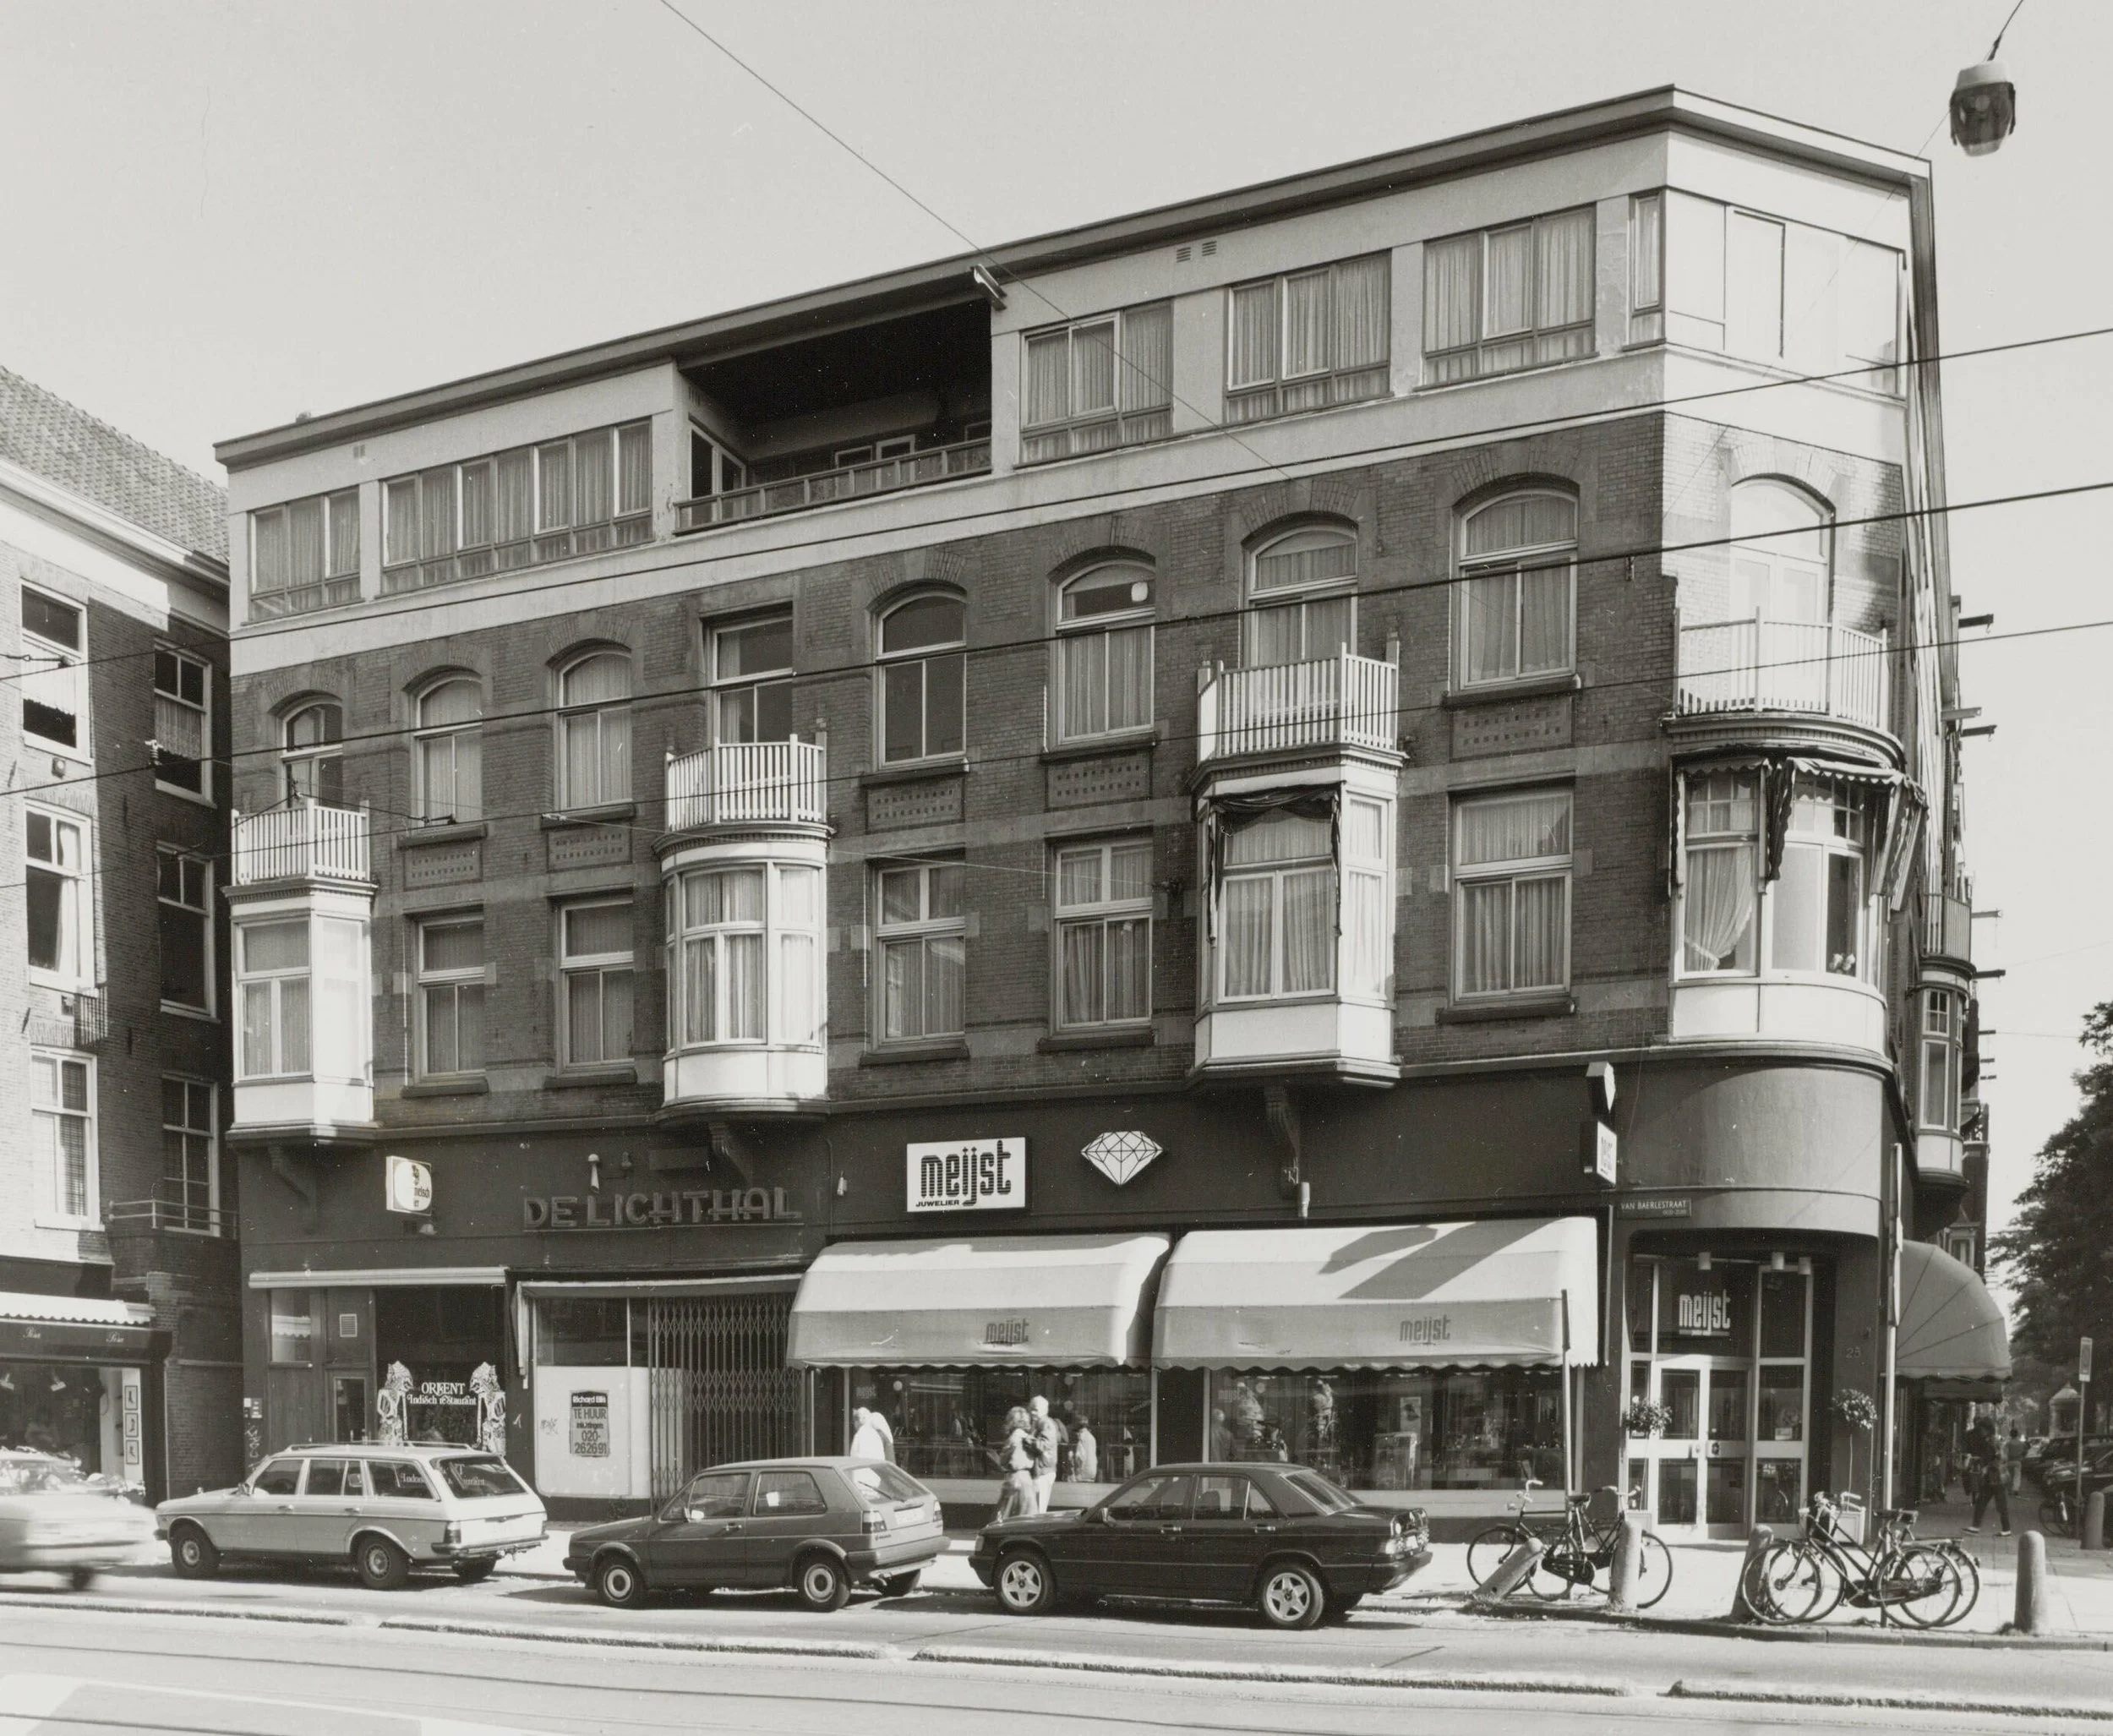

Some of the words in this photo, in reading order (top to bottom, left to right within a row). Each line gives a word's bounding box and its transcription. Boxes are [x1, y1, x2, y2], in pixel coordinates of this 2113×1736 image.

[920, 1139, 1012, 1207] meijst
[523, 1196, 577, 1227] DE
[587, 1187, 802, 1226] LICHTHAL
[1637, 1200, 1686, 1209] BAERLESTRAAT
[1679, 1288, 1731, 1335] meijst
[985, 1318, 1029, 1344] meijst
[1399, 1314, 1451, 1346] meijst
[421, 1382, 465, 1396] ORIENT
[574, 1408, 582, 1419] TE
[583, 1408, 607, 1419] HUUR
